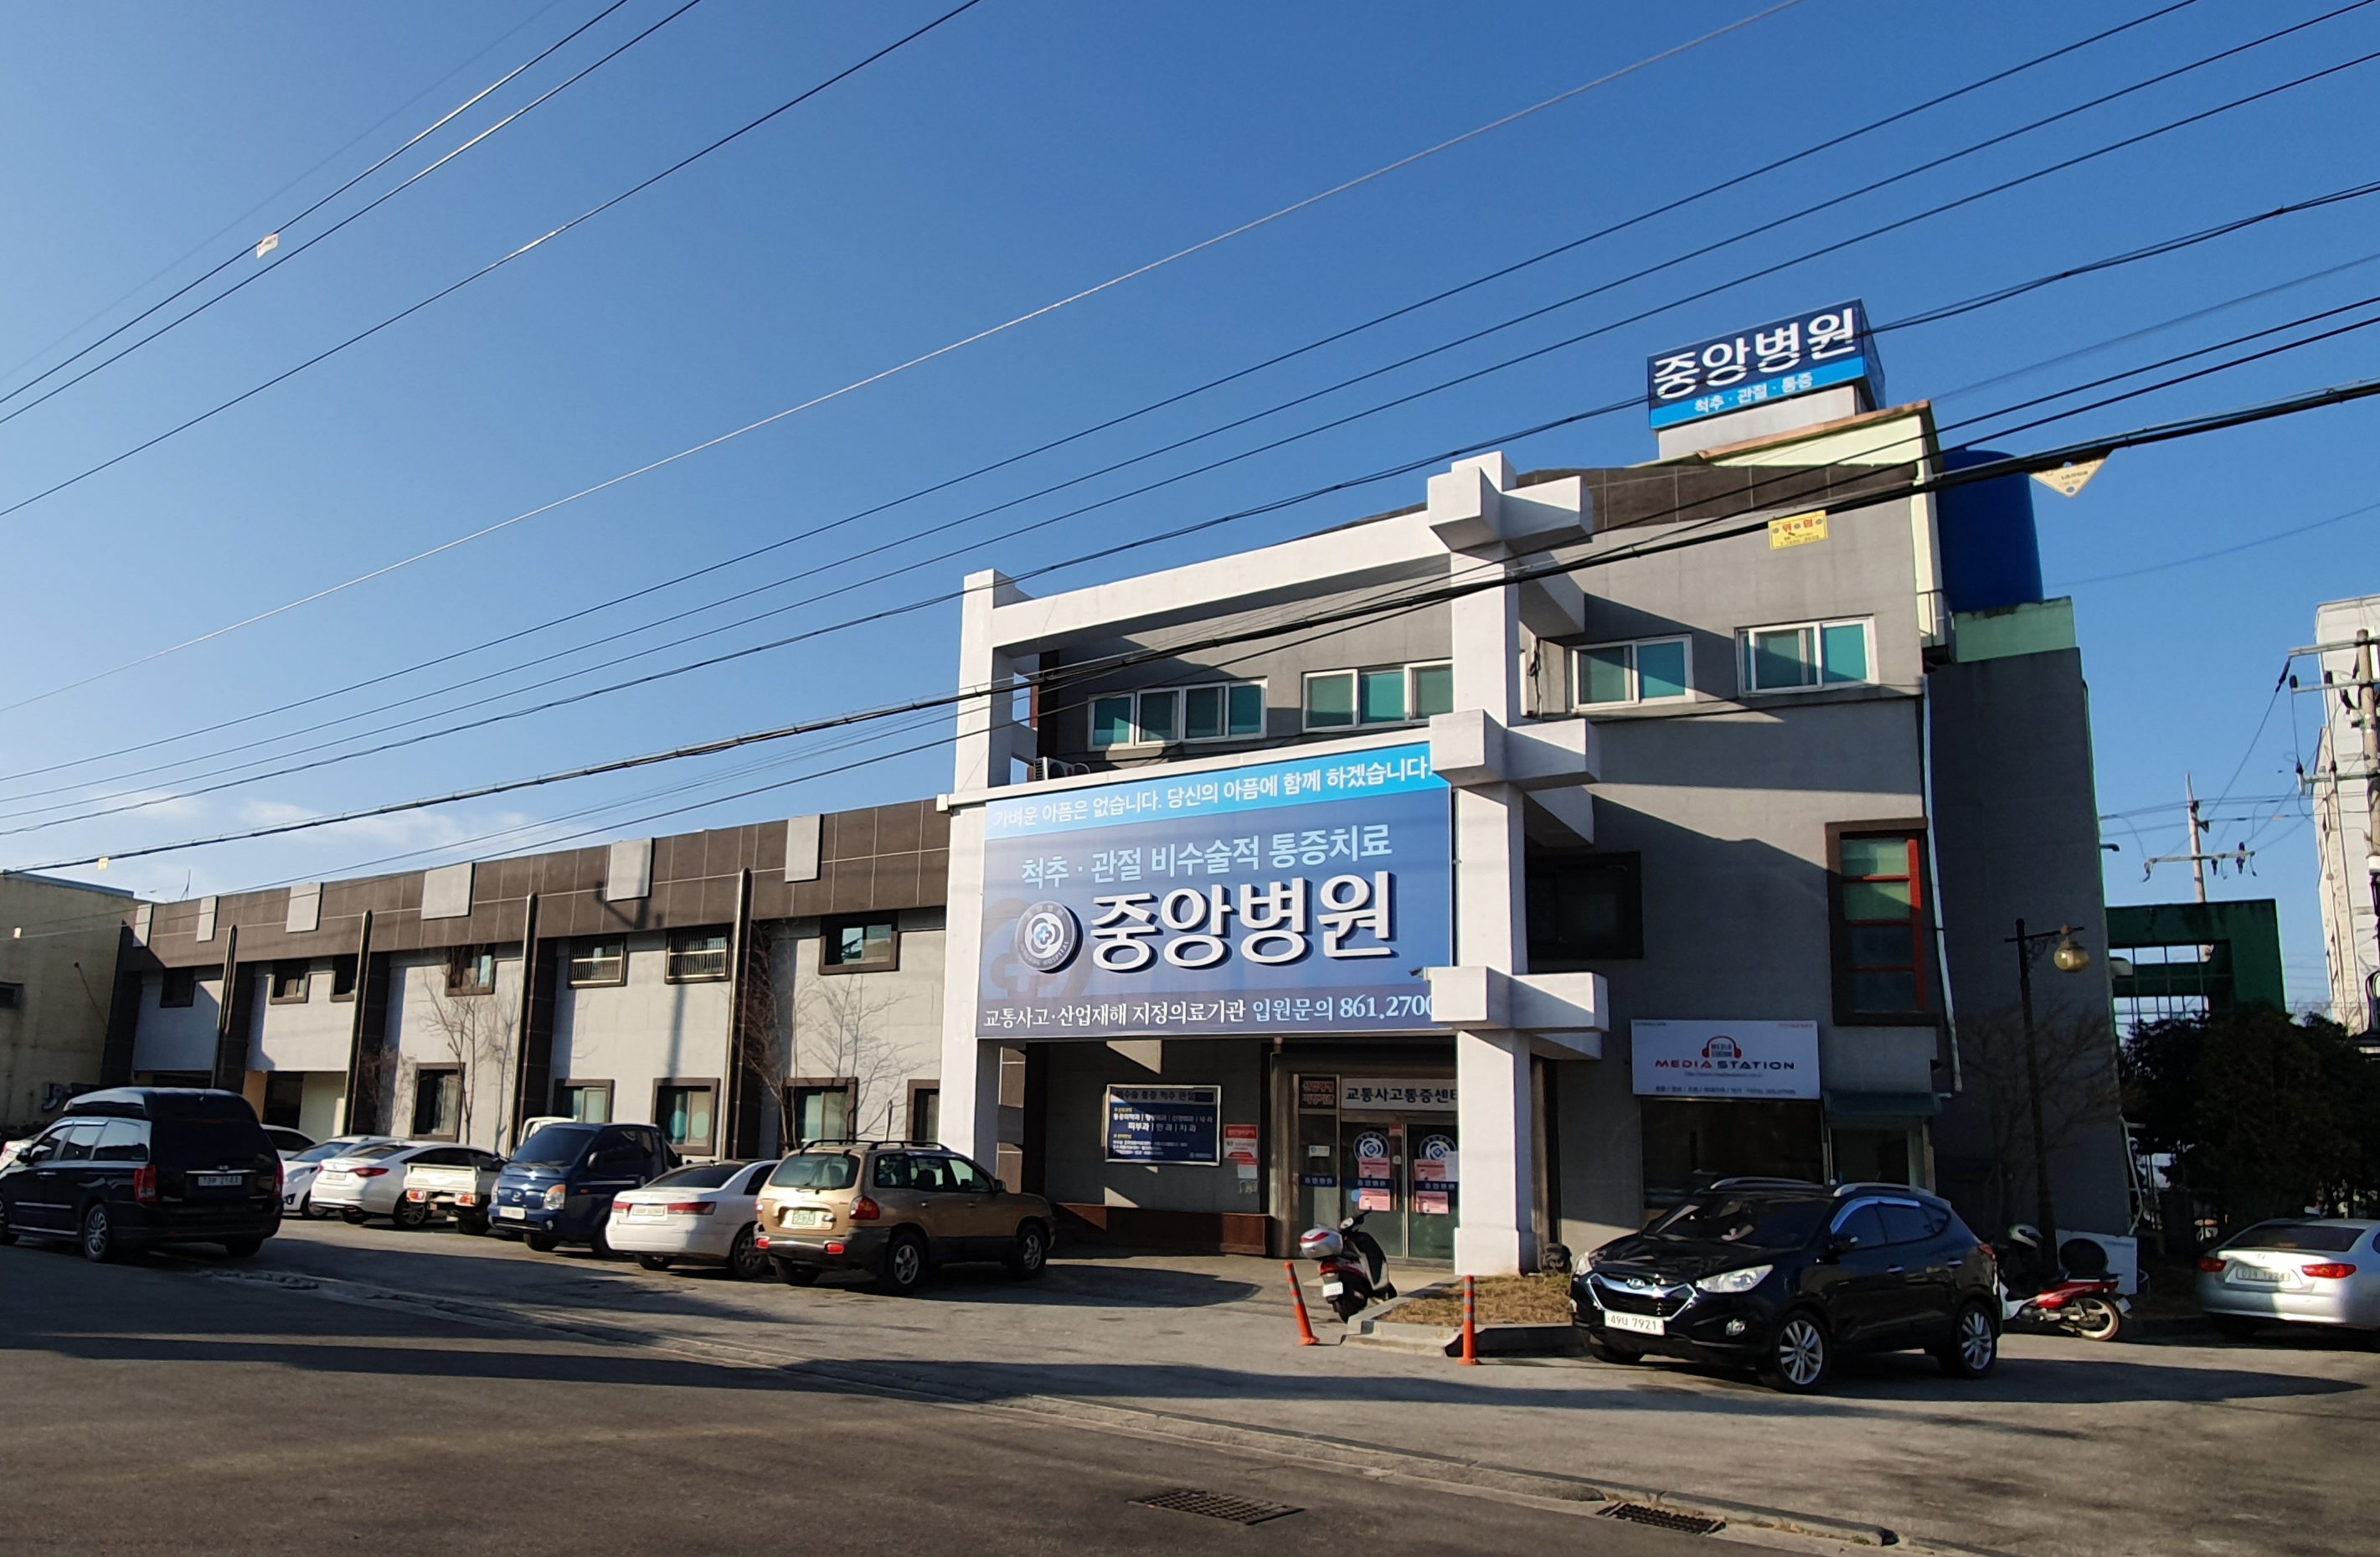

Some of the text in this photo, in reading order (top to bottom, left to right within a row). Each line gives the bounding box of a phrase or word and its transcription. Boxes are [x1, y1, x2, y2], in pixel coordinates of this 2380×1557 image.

[1653, 307, 1856, 400] 중앙병원
[1694, 372, 1813, 413] 척추 관절 통증
[994, 755, 1433, 828] 가벼운 아픔은 없습니다. 당신의 아픔에 함께 하겠습니다.
[1021, 824, 1393, 889] 척추 관절 비수술적 통증치료
[1090, 870, 1393, 972] 중앙병원
[1132, 999, 1247, 1027] 지정의료기관
[1253, 996, 1334, 1022] 입원문의
[1655, 1059, 1795, 1070] MEDIA STATION
[1631, 1317, 1656, 1331] 7921
